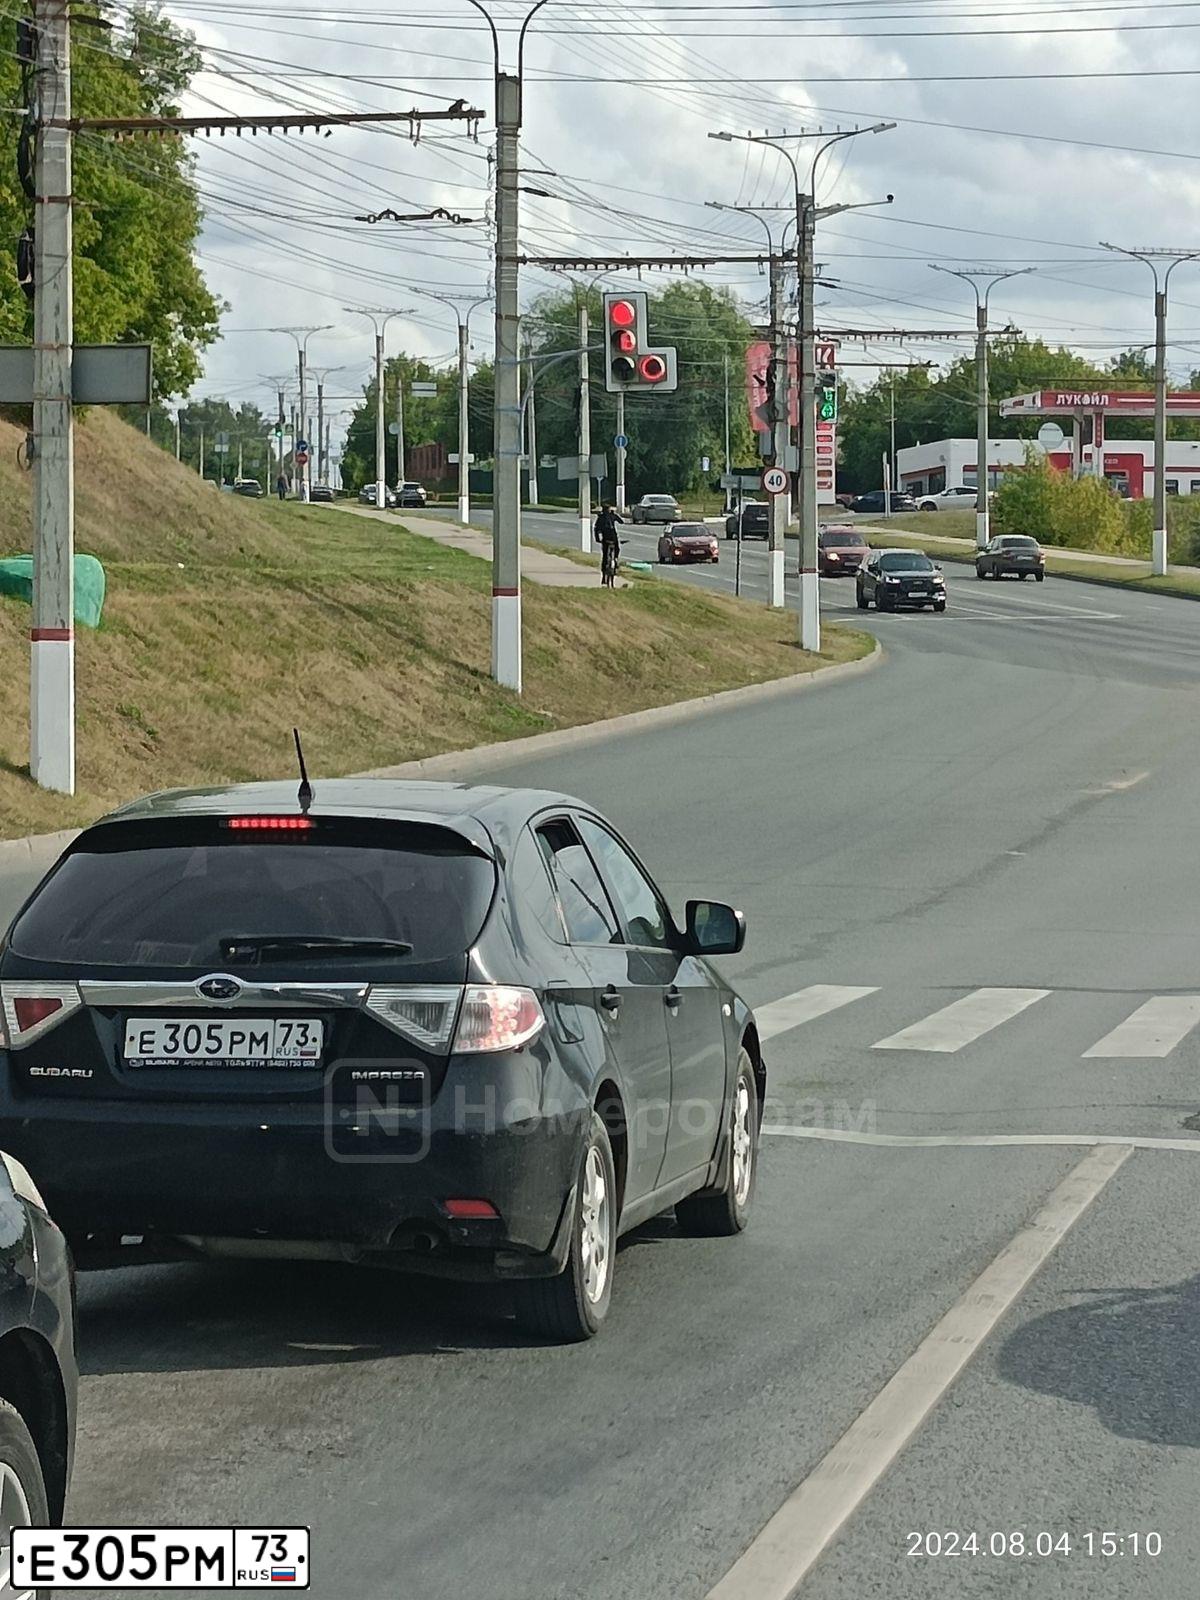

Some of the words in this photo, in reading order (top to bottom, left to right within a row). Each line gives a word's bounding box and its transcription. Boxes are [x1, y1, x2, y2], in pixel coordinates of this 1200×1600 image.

[1056, 392, 1109, 406] ЛУКОЙЛ
[768, 475, 783, 486] 40
[279, 1023, 310, 1047] 73
[275, 1047, 299, 1056] RUS
[29, 1067, 93, 1078] SUBARU
